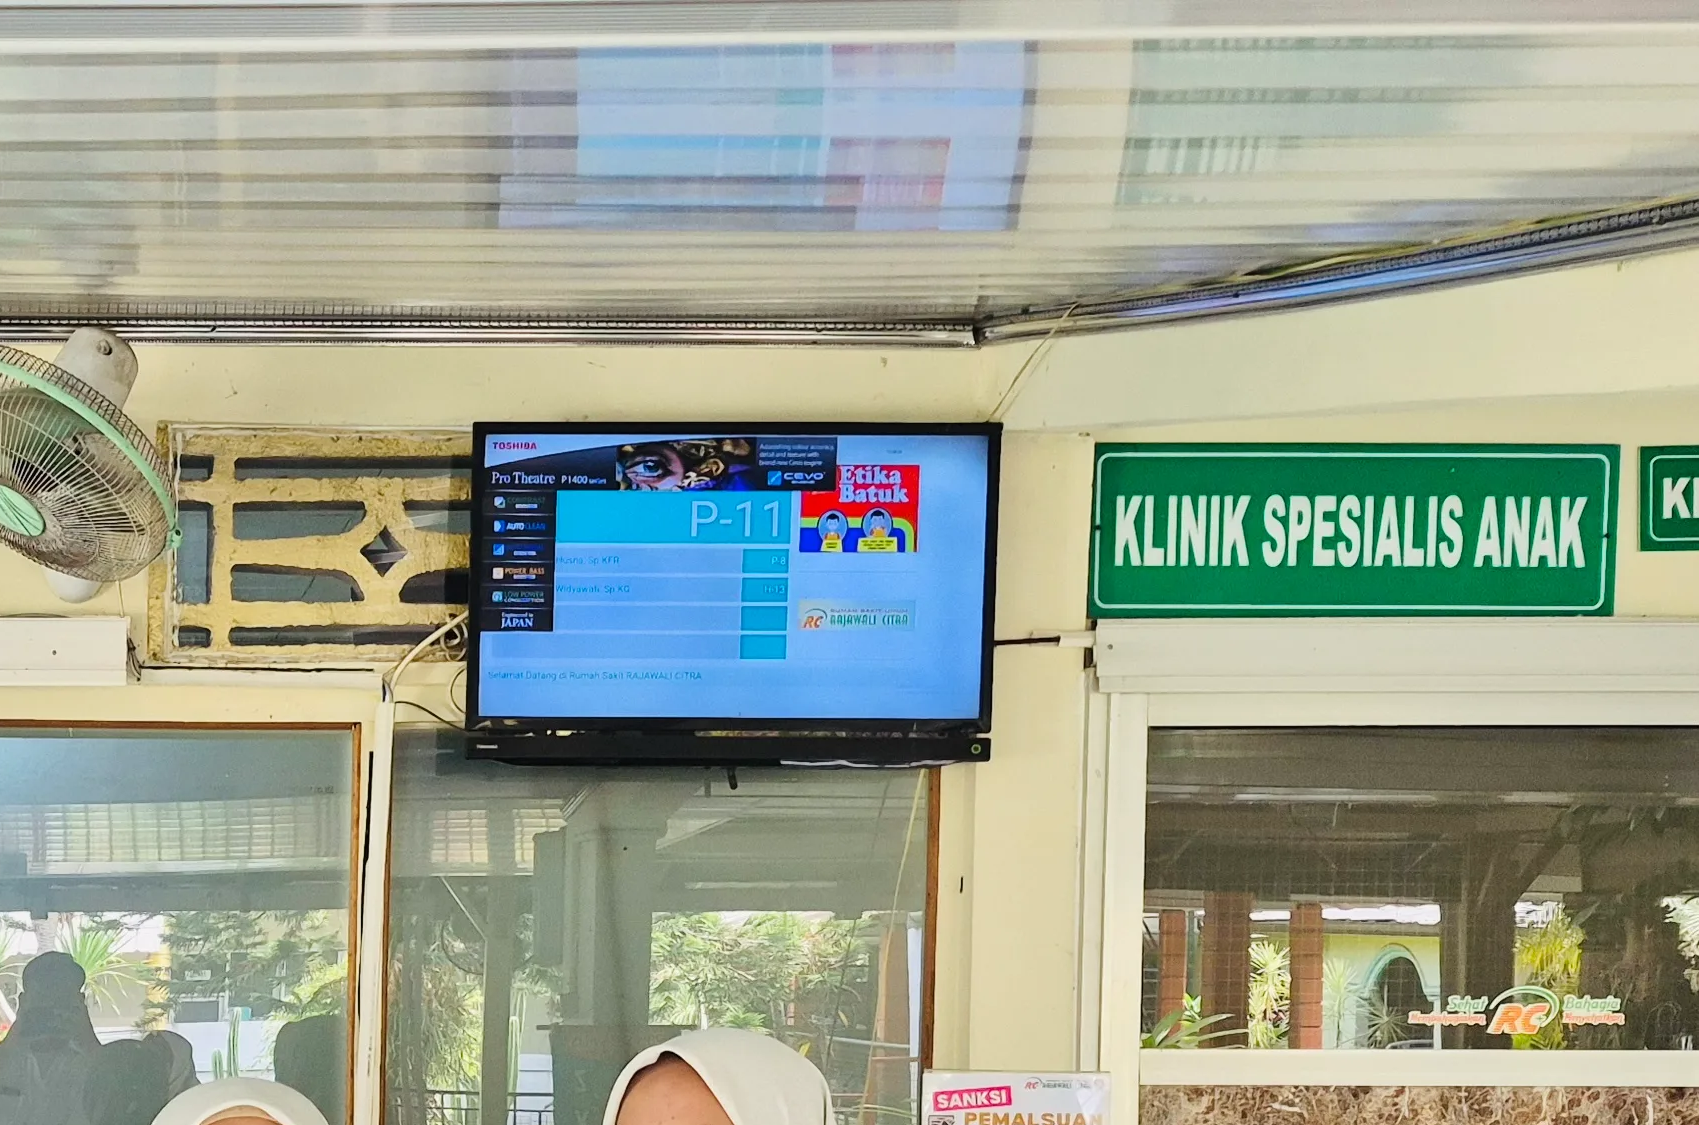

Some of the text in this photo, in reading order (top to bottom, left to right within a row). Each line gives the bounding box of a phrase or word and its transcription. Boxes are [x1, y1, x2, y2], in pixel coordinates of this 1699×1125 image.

[493, 442, 537, 450] TOSHIBA
[491, 472, 511, 484] Pro
[513, 472, 556, 484] Theatre
[561, 475, 588, 484] P1400
[839, 466, 901, 484] Etika
[839, 484, 909, 503] Batuk
[690, 500, 779, 537] P-11
[1114, 494, 1588, 569] KLINIK SPESIALIS ANAK
[501, 617, 534, 629] JAPAN
[830, 614, 908, 627] RAJAWALI CITRA
[526, 671, 557, 682] Datang
[569, 671, 600, 680] Rumah
[626, 671, 673, 680] RAJAWALI
[1448, 996, 1621, 1034] Sehat RC Bahagia
[936, 1090, 1008, 1109] SANKSI
